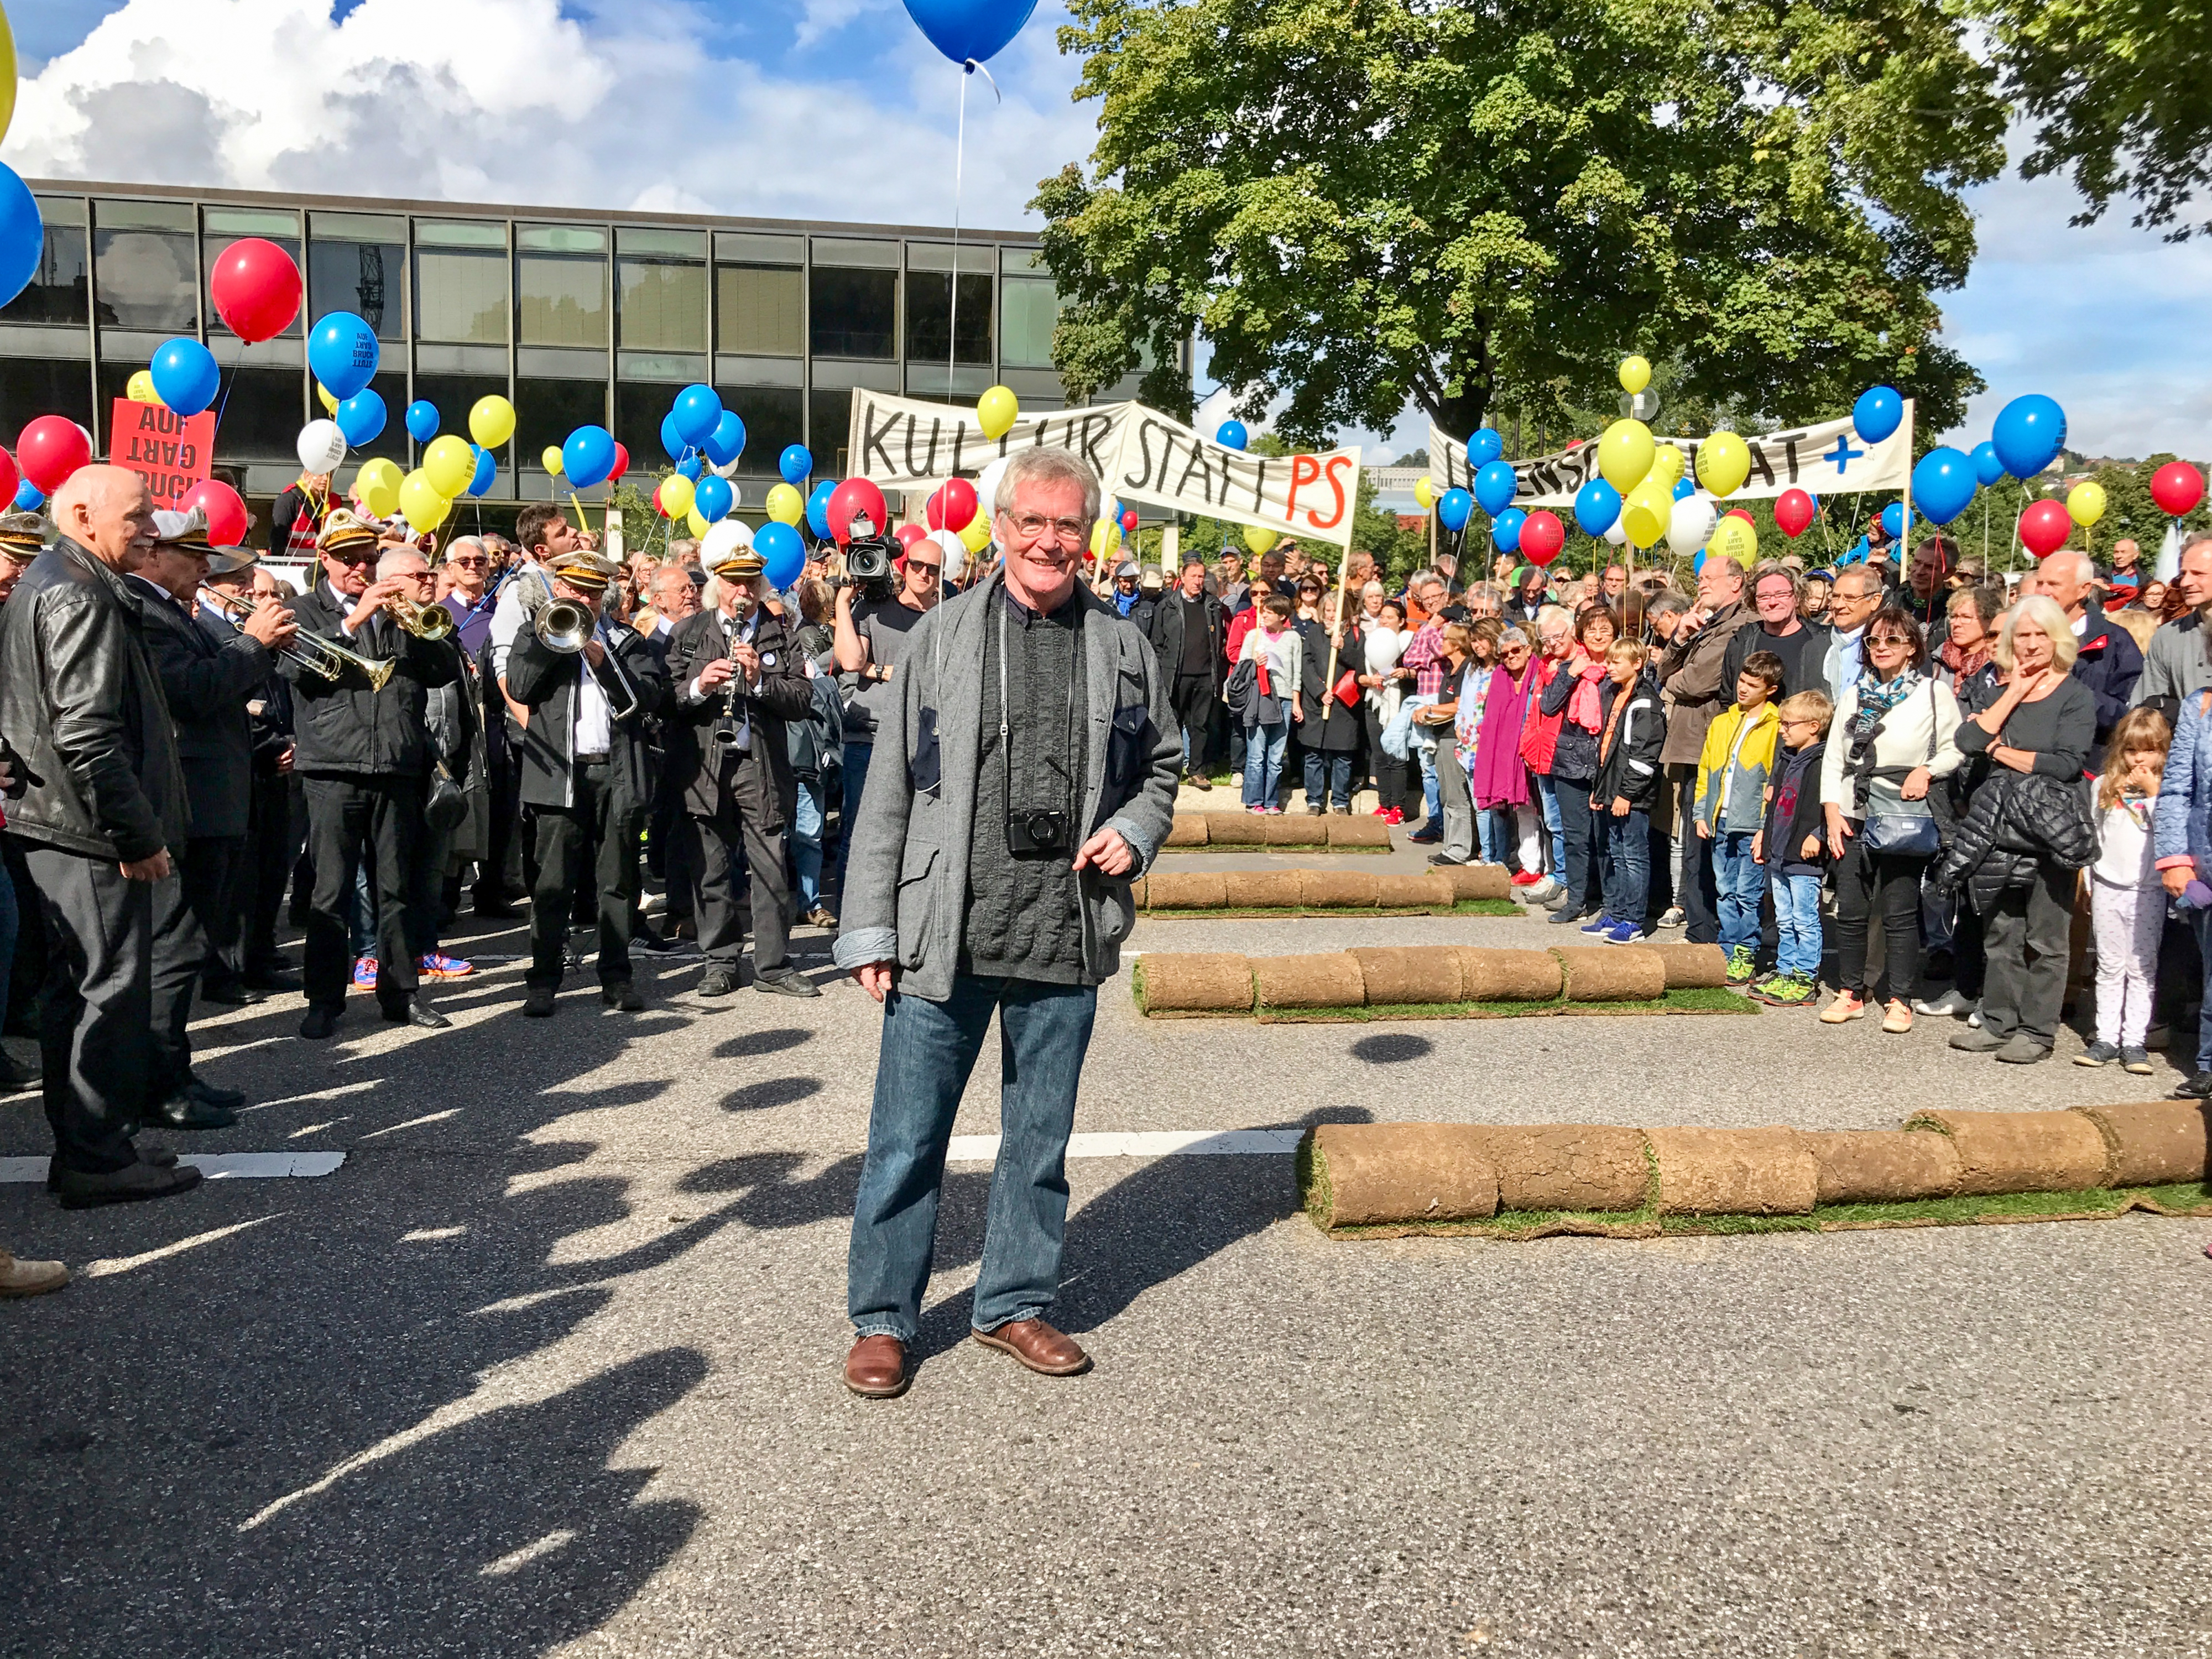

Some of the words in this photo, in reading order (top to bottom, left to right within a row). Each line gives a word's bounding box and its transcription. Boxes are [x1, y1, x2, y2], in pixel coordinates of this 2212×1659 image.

[353, 350, 374, 359] BRUCH
[355, 341, 372, 350] GART
[352, 359, 373, 368] STUTT
[139, 406, 189, 436] AUF
[126, 437, 196, 469] GART
[1124, 418, 1280, 514] STATT
[1285, 455, 1353, 529] PS
